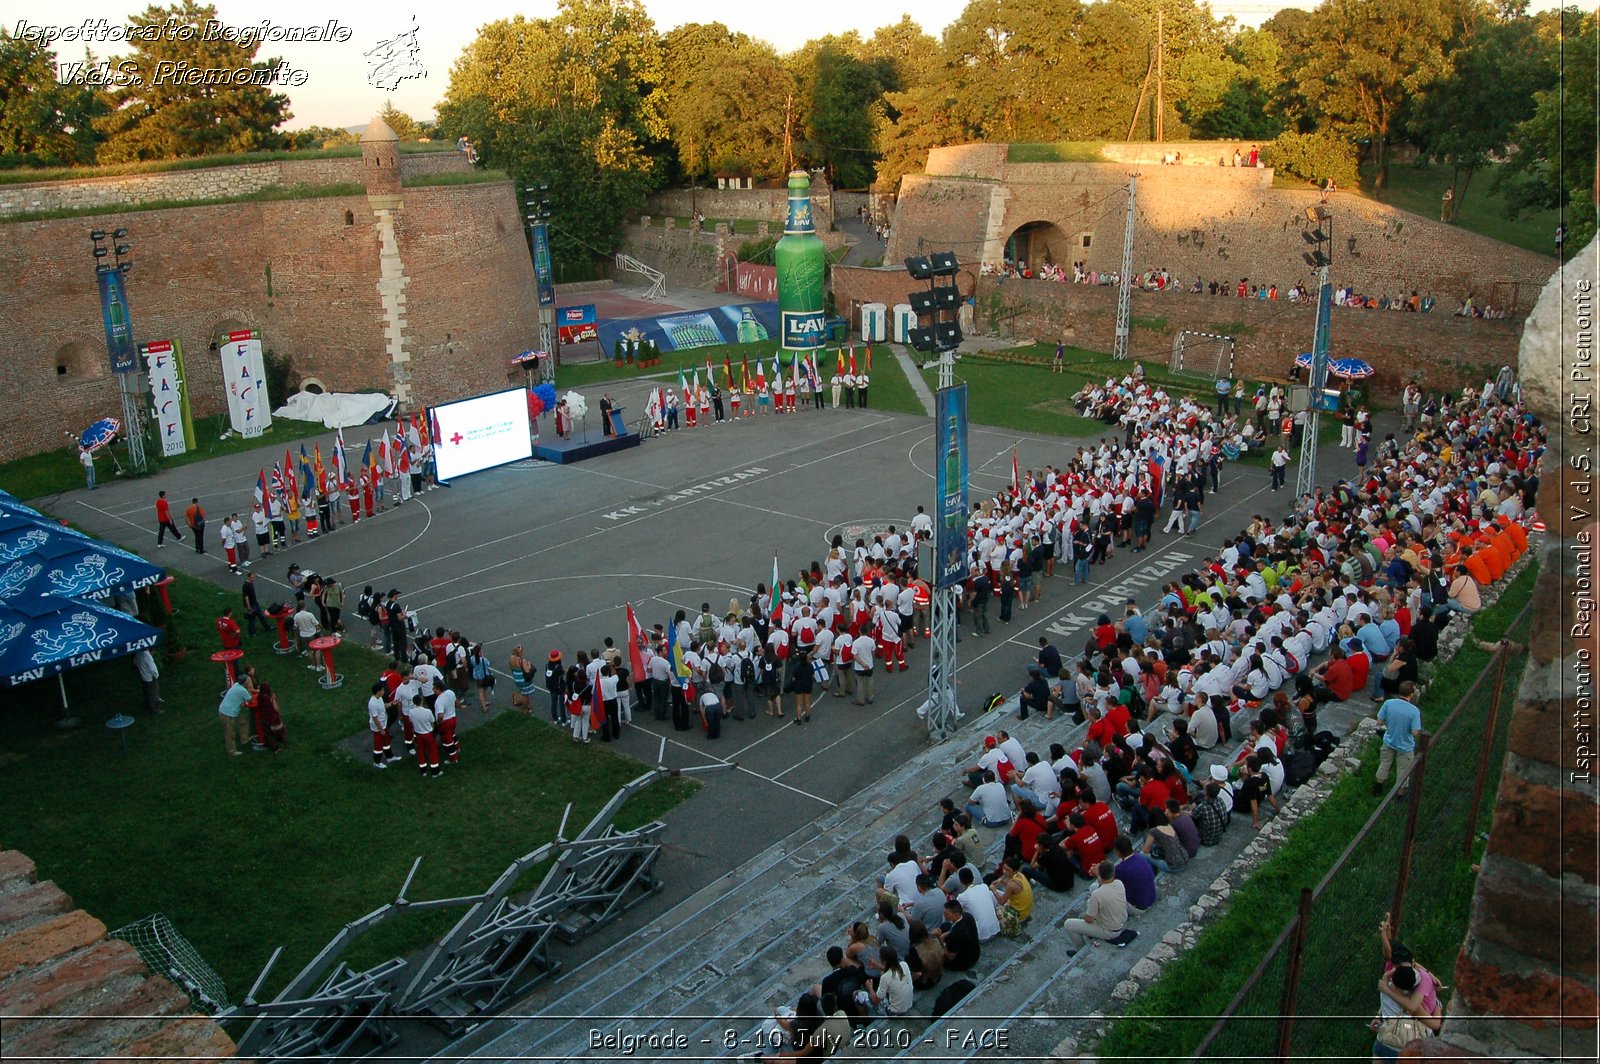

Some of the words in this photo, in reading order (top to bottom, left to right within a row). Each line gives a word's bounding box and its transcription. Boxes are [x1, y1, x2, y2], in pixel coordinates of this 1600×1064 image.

[790, 317, 825, 334] LAV
[245, 425, 262, 435] 2010
[165, 440, 184, 452] 2010
[602, 505, 649, 520] KK
[132, 574, 160, 589] LAV
[1045, 612, 1097, 637] KK
[1081, 551, 1194, 613] PARTIZAN
[10, 666, 45, 686] LAV
[69, 650, 102, 667] LAV
[126, 635, 158, 652] LAV
